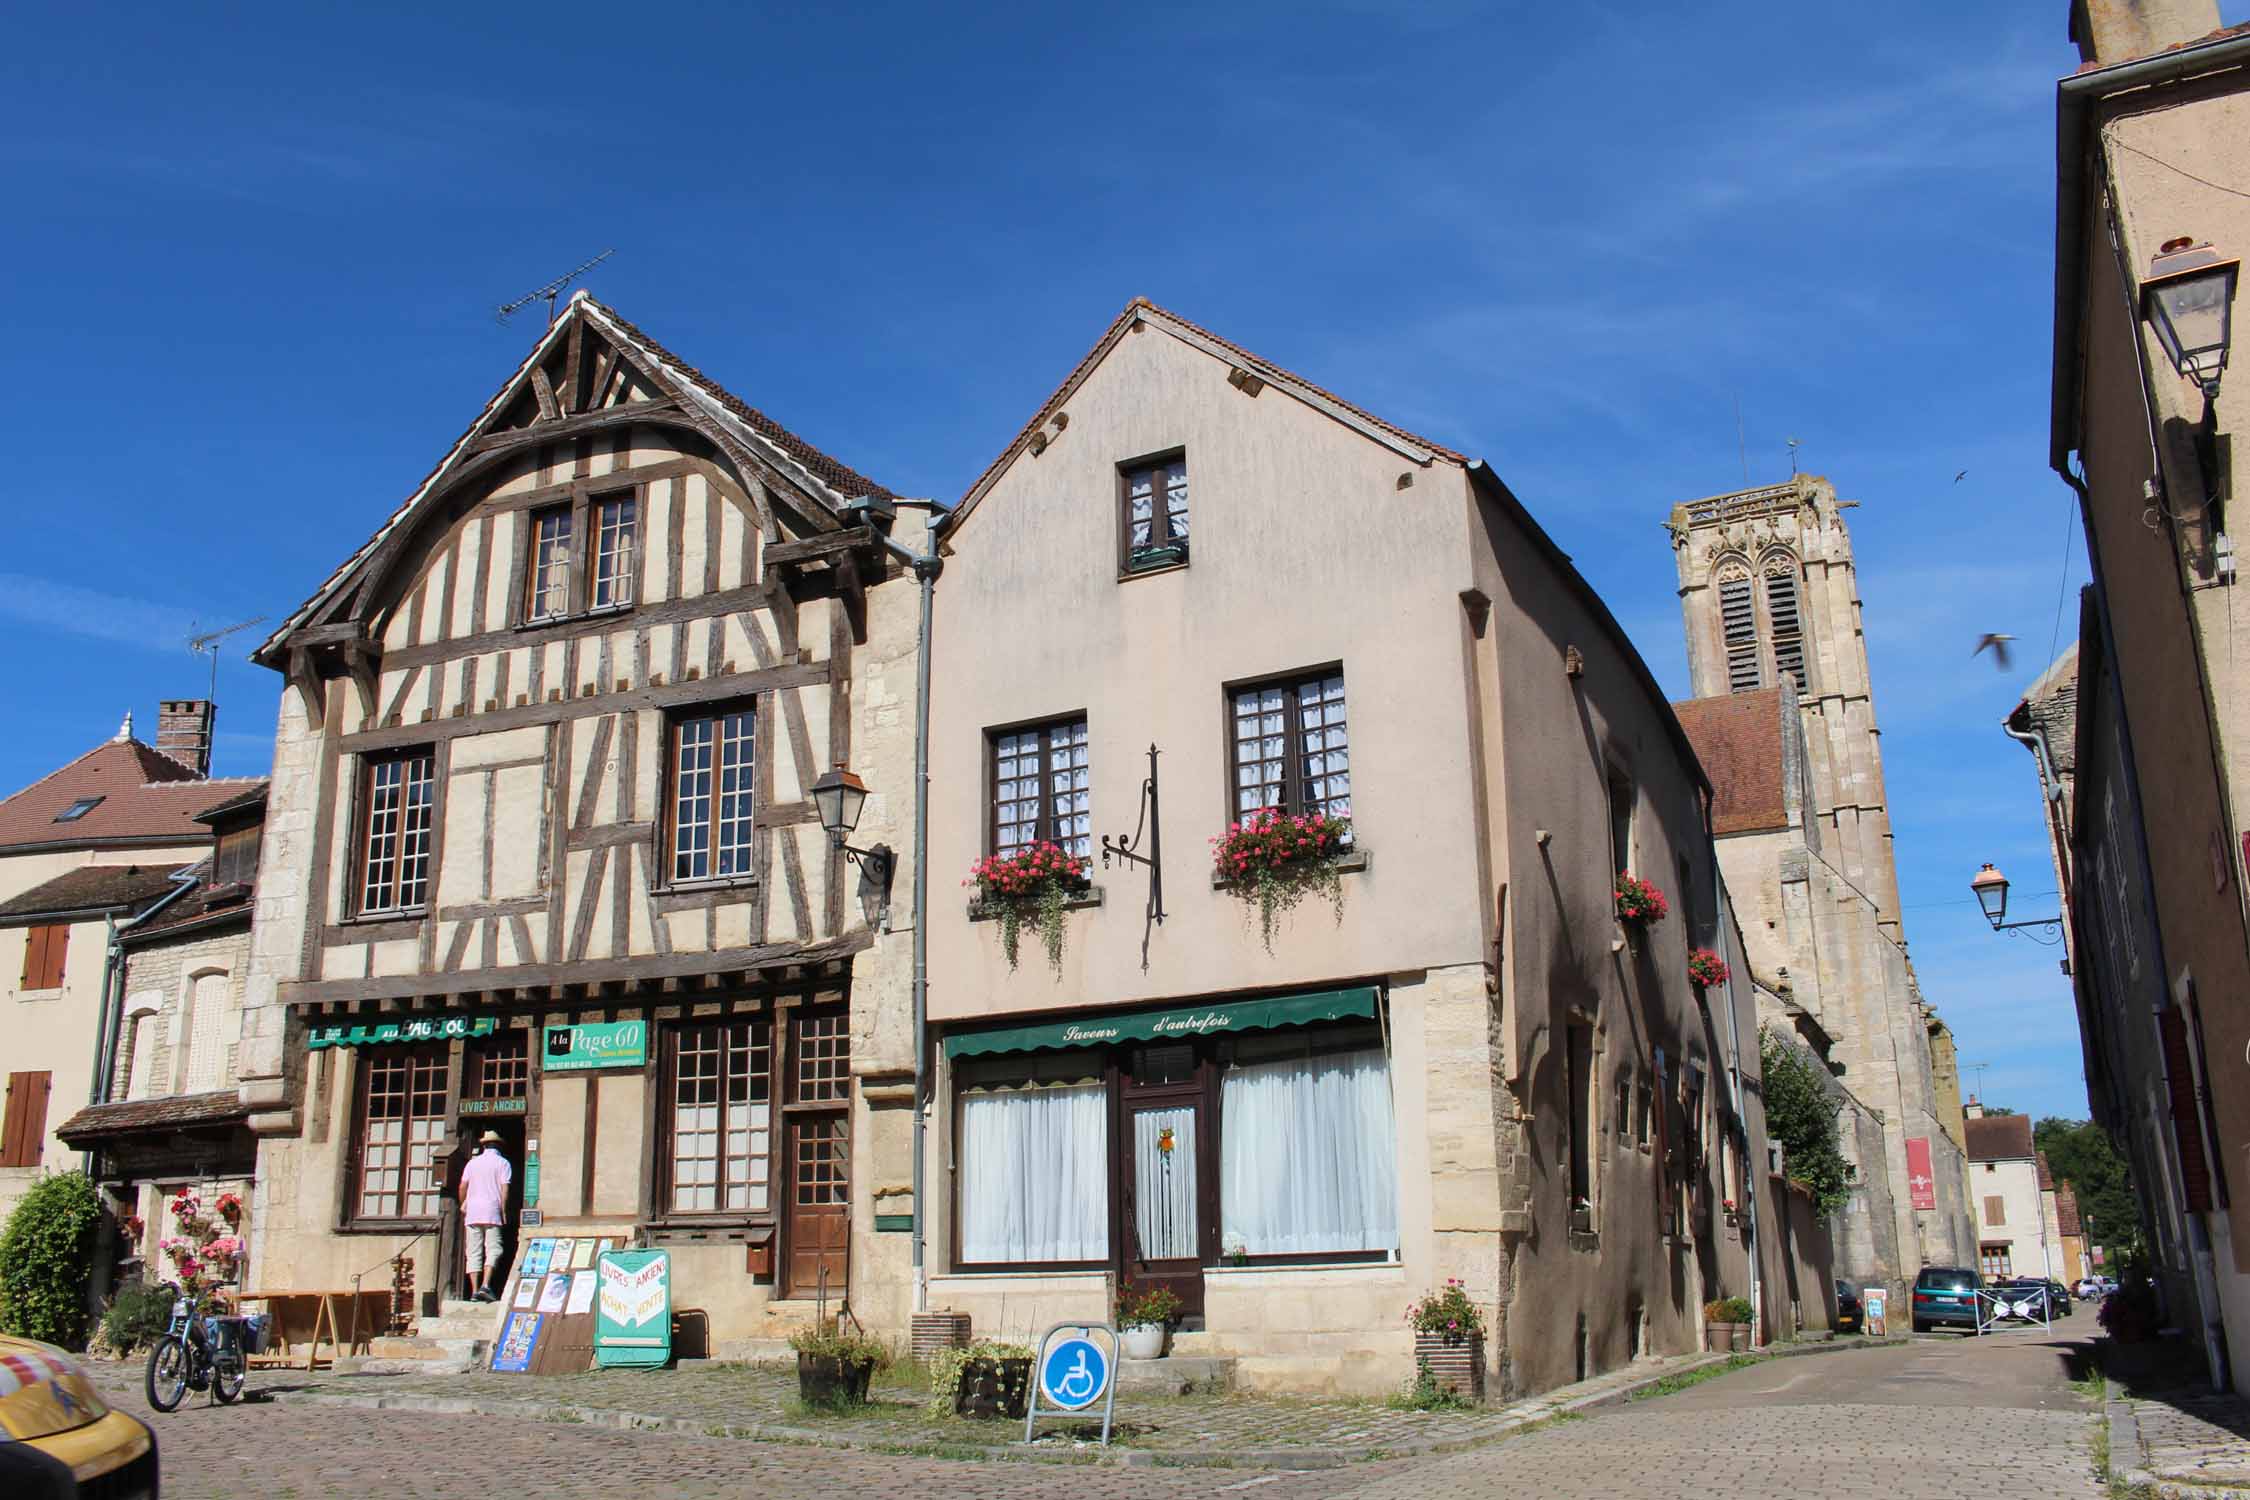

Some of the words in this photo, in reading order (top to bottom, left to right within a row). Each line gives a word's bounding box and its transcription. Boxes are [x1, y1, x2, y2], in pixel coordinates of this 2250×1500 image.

[1063, 1026, 1119, 1041] Saveurs
[1153, 1012, 1232, 1033] d'autrefois
[559, 1033, 568, 1045] la
[569, 1028, 612, 1058] Page
[615, 1024, 640, 1048] 60
[460, 1101, 490, 1113] LIVRES
[493, 1099, 526, 1112] ANCIENS
[602, 1261, 629, 1288] LIVRES
